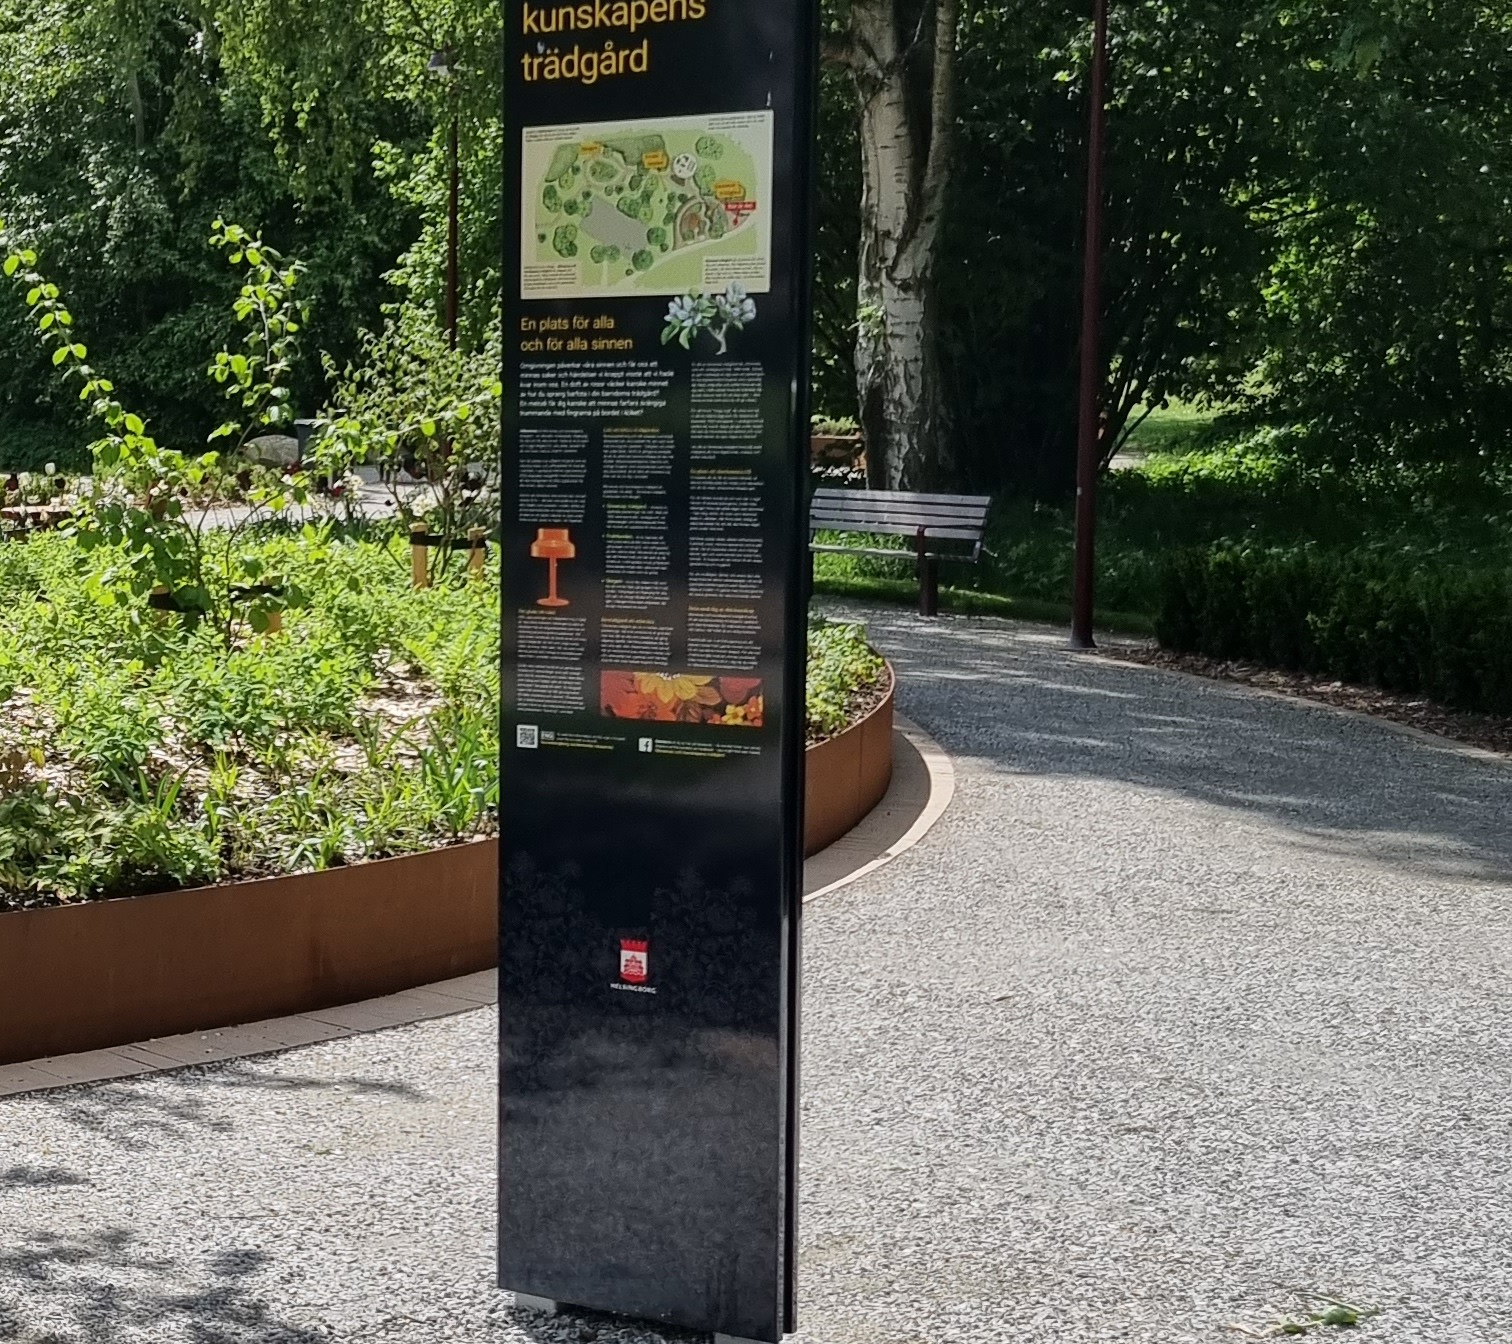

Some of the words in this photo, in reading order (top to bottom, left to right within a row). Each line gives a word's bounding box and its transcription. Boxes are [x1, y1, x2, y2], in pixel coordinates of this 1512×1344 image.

[521, 38, 648, 84] trädgård
[521, 317, 536, 331] En
[539, 316, 568, 333] plats
[573, 315, 589, 329] för
[593, 315, 615, 329] alla
[520, 338, 543, 352] och
[547, 337, 563, 351] för
[567, 337, 588, 351] alla
[591, 338, 633, 350] sinnen
